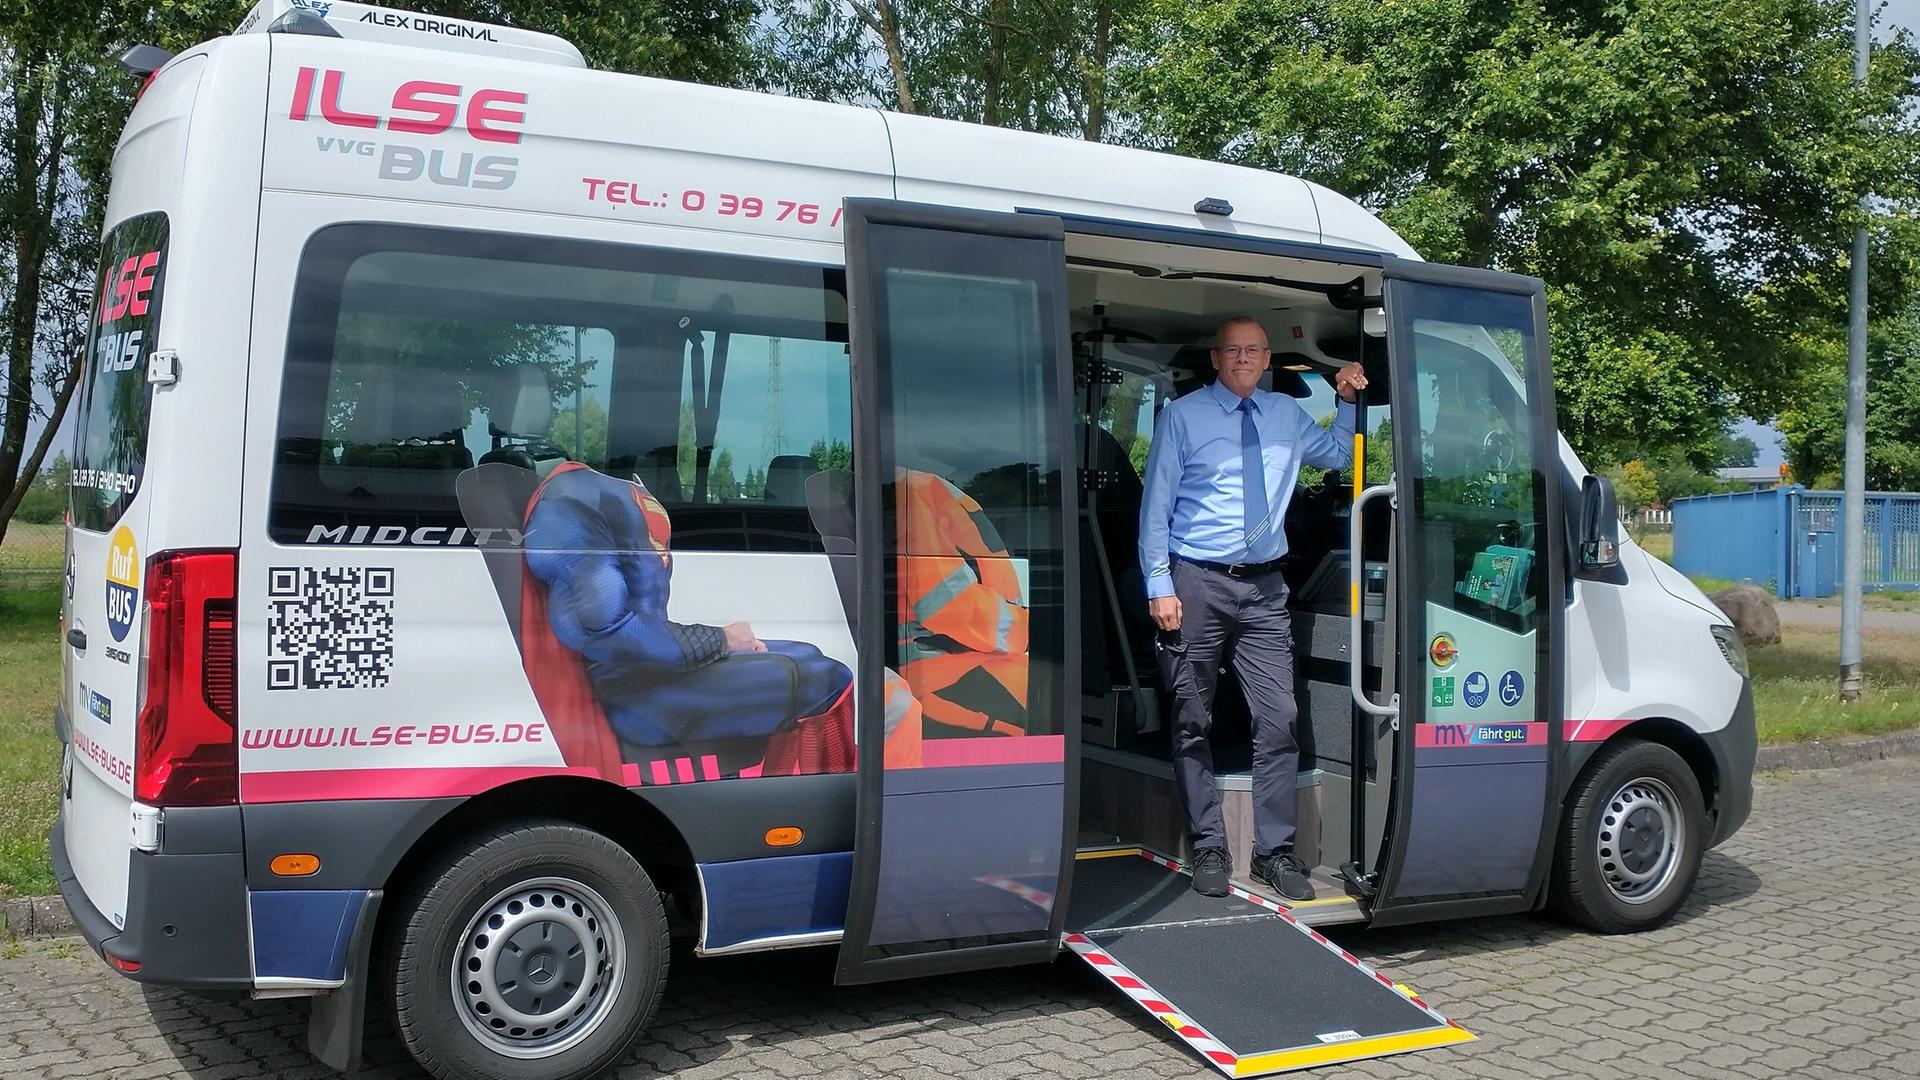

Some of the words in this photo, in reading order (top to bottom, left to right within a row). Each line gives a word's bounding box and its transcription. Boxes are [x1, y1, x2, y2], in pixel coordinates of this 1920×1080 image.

[359, 11, 409, 29] ALEX
[413, 18, 498, 43] ORIGINAL
[288, 66, 529, 145] ILSE
[316, 136, 376, 156] VVG
[378, 144, 519, 191] BUS
[582, 177, 668, 208] TEL.:
[681, 190, 705, 212] 0
[718, 193, 764, 218] 39
[776, 200, 819, 224] 76
[98, 251, 160, 325] ILSE
[103, 330, 143, 373] BUS
[114, 472, 136, 495] 240
[305, 524, 538, 546] MIDCITY
[111, 545, 134, 581] Ruf
[108, 586, 132, 625] BUS
[241, 722, 545, 750] WWW.ILSE-BUS.DE
[1478, 727, 1503, 740] fährt
[1504, 730, 1525, 742] gut.
